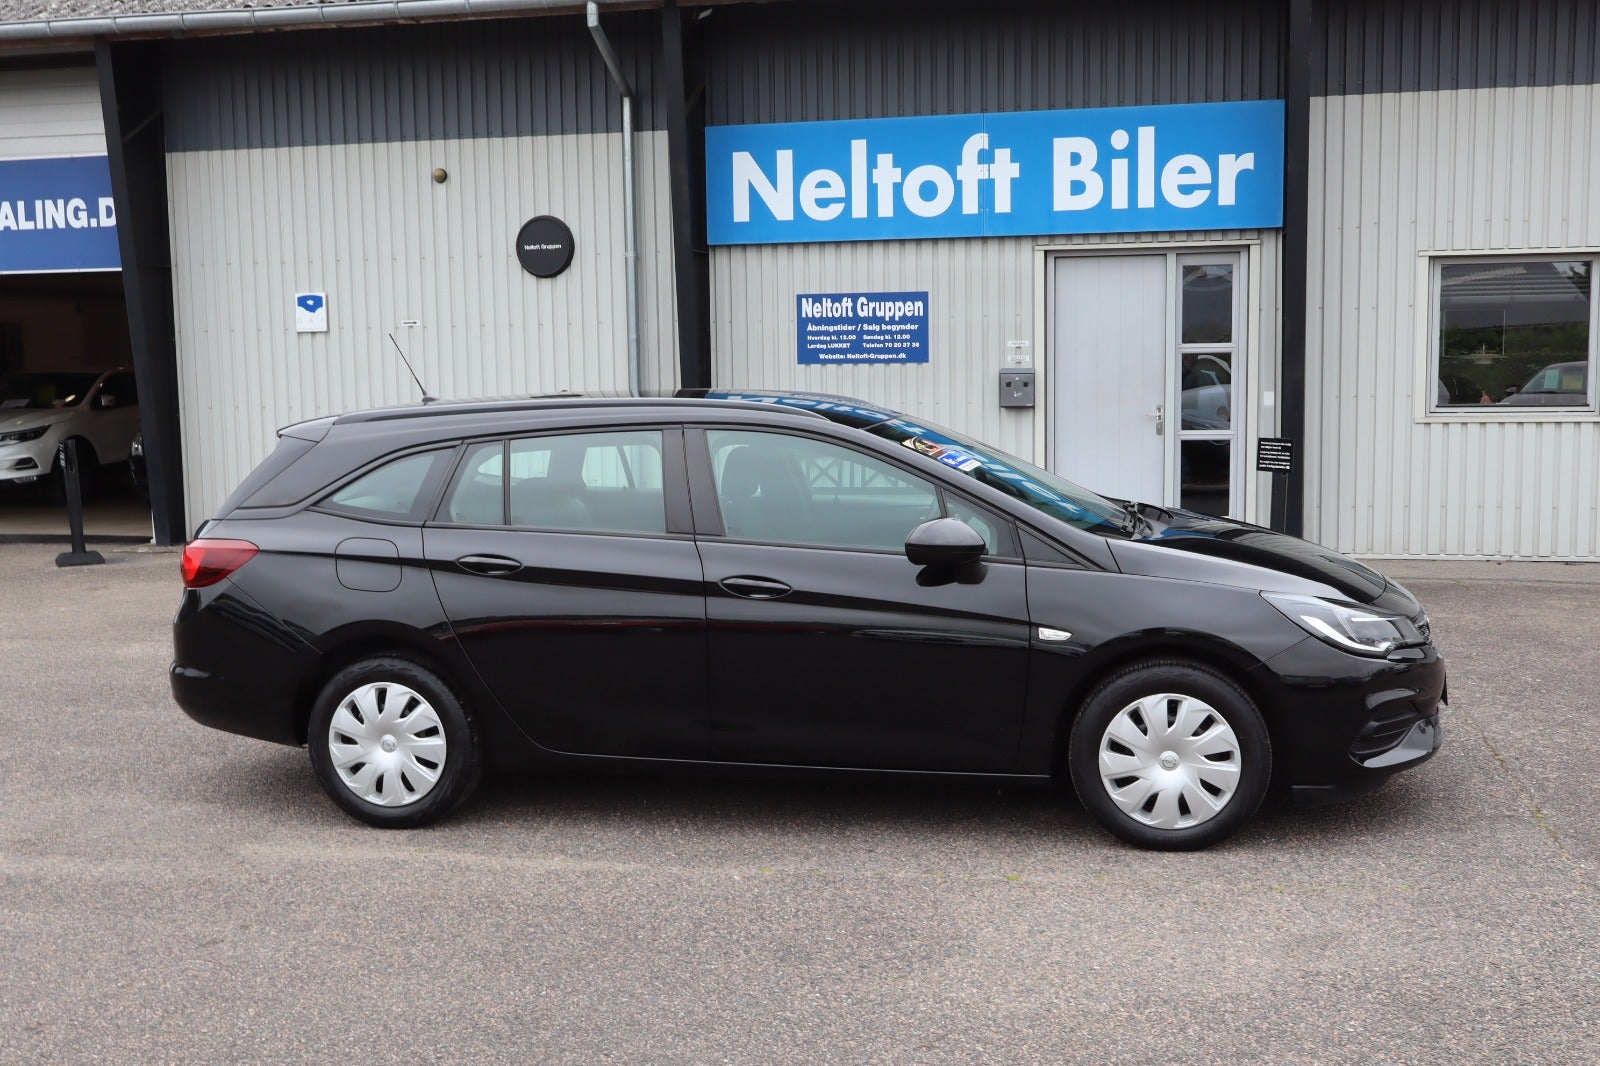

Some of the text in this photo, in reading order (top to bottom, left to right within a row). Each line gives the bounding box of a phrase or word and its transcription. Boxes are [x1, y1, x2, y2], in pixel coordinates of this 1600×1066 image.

[732, 125, 1255, 223] Neltoft Biler
[801, 296, 924, 321] Neltoft Gruppen
[807, 322, 856, 332] Åbningstider
[862, 323, 880, 331] Salg
[882, 323, 918, 331] begynder
